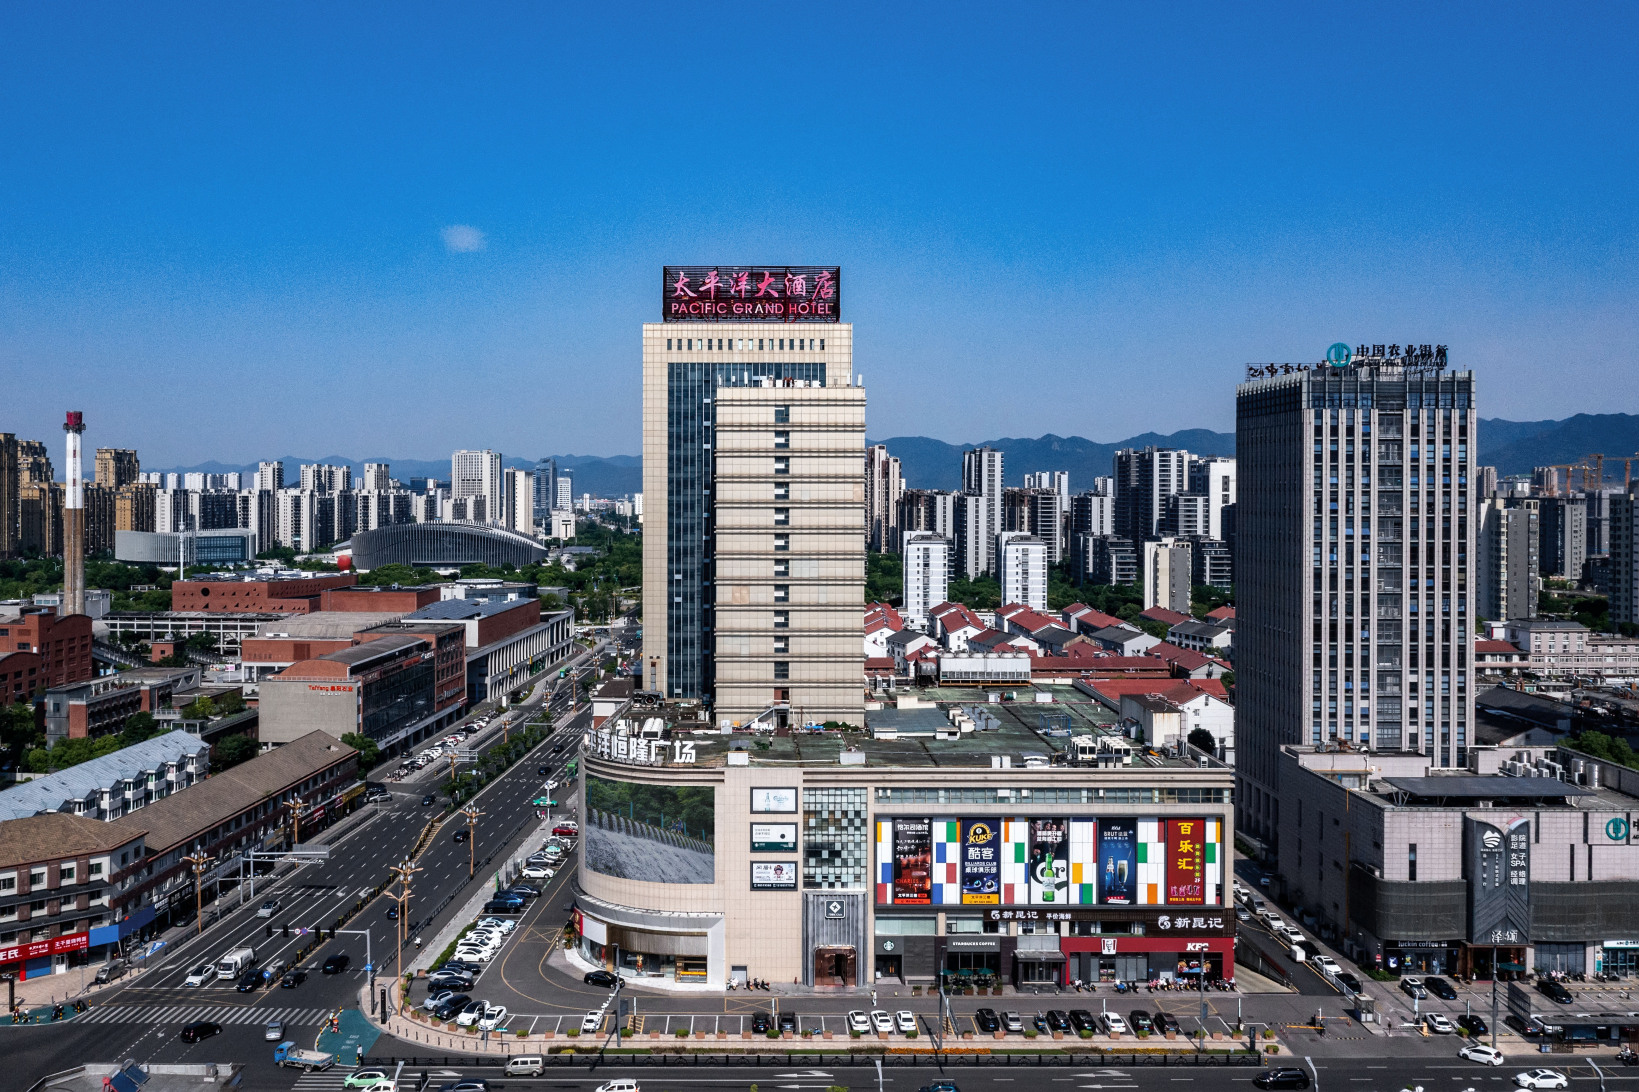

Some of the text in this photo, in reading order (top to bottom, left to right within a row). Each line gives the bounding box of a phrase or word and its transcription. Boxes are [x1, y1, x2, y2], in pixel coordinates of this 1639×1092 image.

[671, 270, 834, 301] 太平洋大酒店
[671, 303, 832, 314] PACIFIC GRAND HOTEL
[969, 834, 993, 844] KUKE
[1177, 822, 1194, 870] 百乐汇
[968, 847, 994, 860] 酷客
[1510, 852, 1527, 860] 女子
[1002, 911, 1038, 919] 新昆记
[1174, 917, 1224, 929] 新昆记
[1186, 943, 1209, 951] KFC
